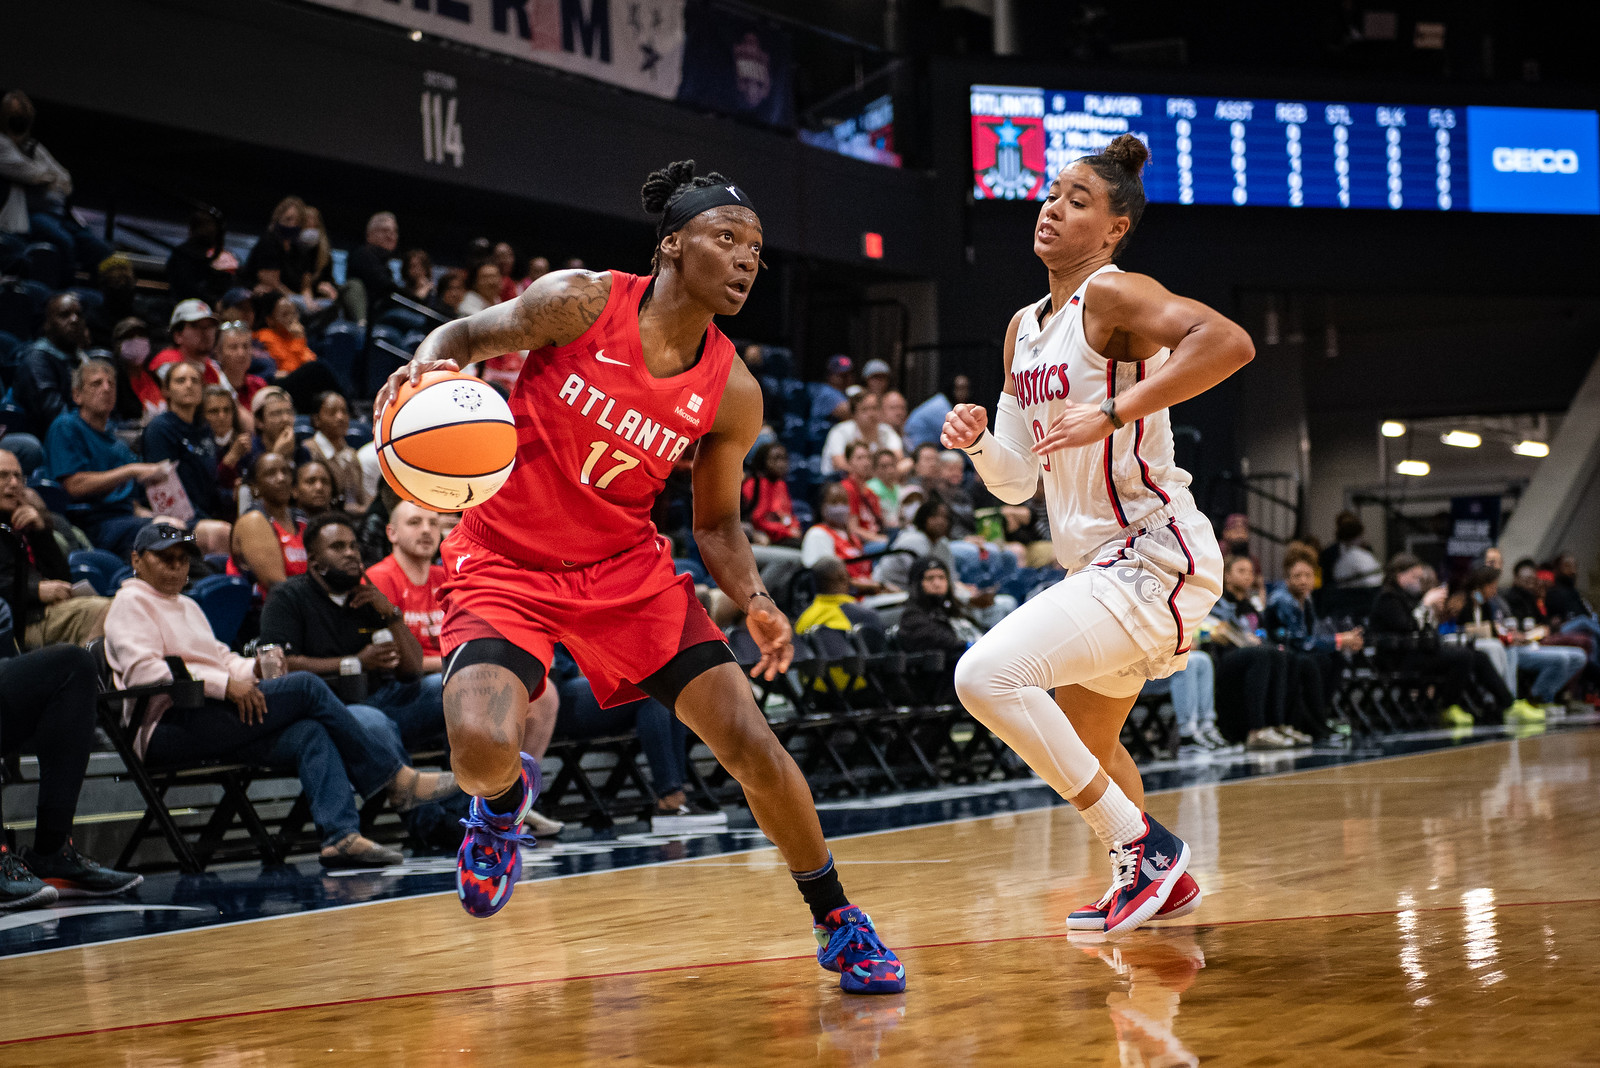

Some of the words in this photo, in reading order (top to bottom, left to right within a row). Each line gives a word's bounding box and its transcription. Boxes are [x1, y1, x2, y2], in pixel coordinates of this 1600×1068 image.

[971, 93, 1044, 117] ATLANTA
[1083, 95, 1143, 117] PLAYER
[1166, 99, 1197, 119] PTS
[1325, 105, 1353, 124] STL
[421, 91, 464, 168] 114
[1493, 147, 1578, 174] GEICO
[558, 373, 690, 462] ATLANTA
[674, 405, 700, 427] Microsoft
[580, 440, 641, 489] 17
